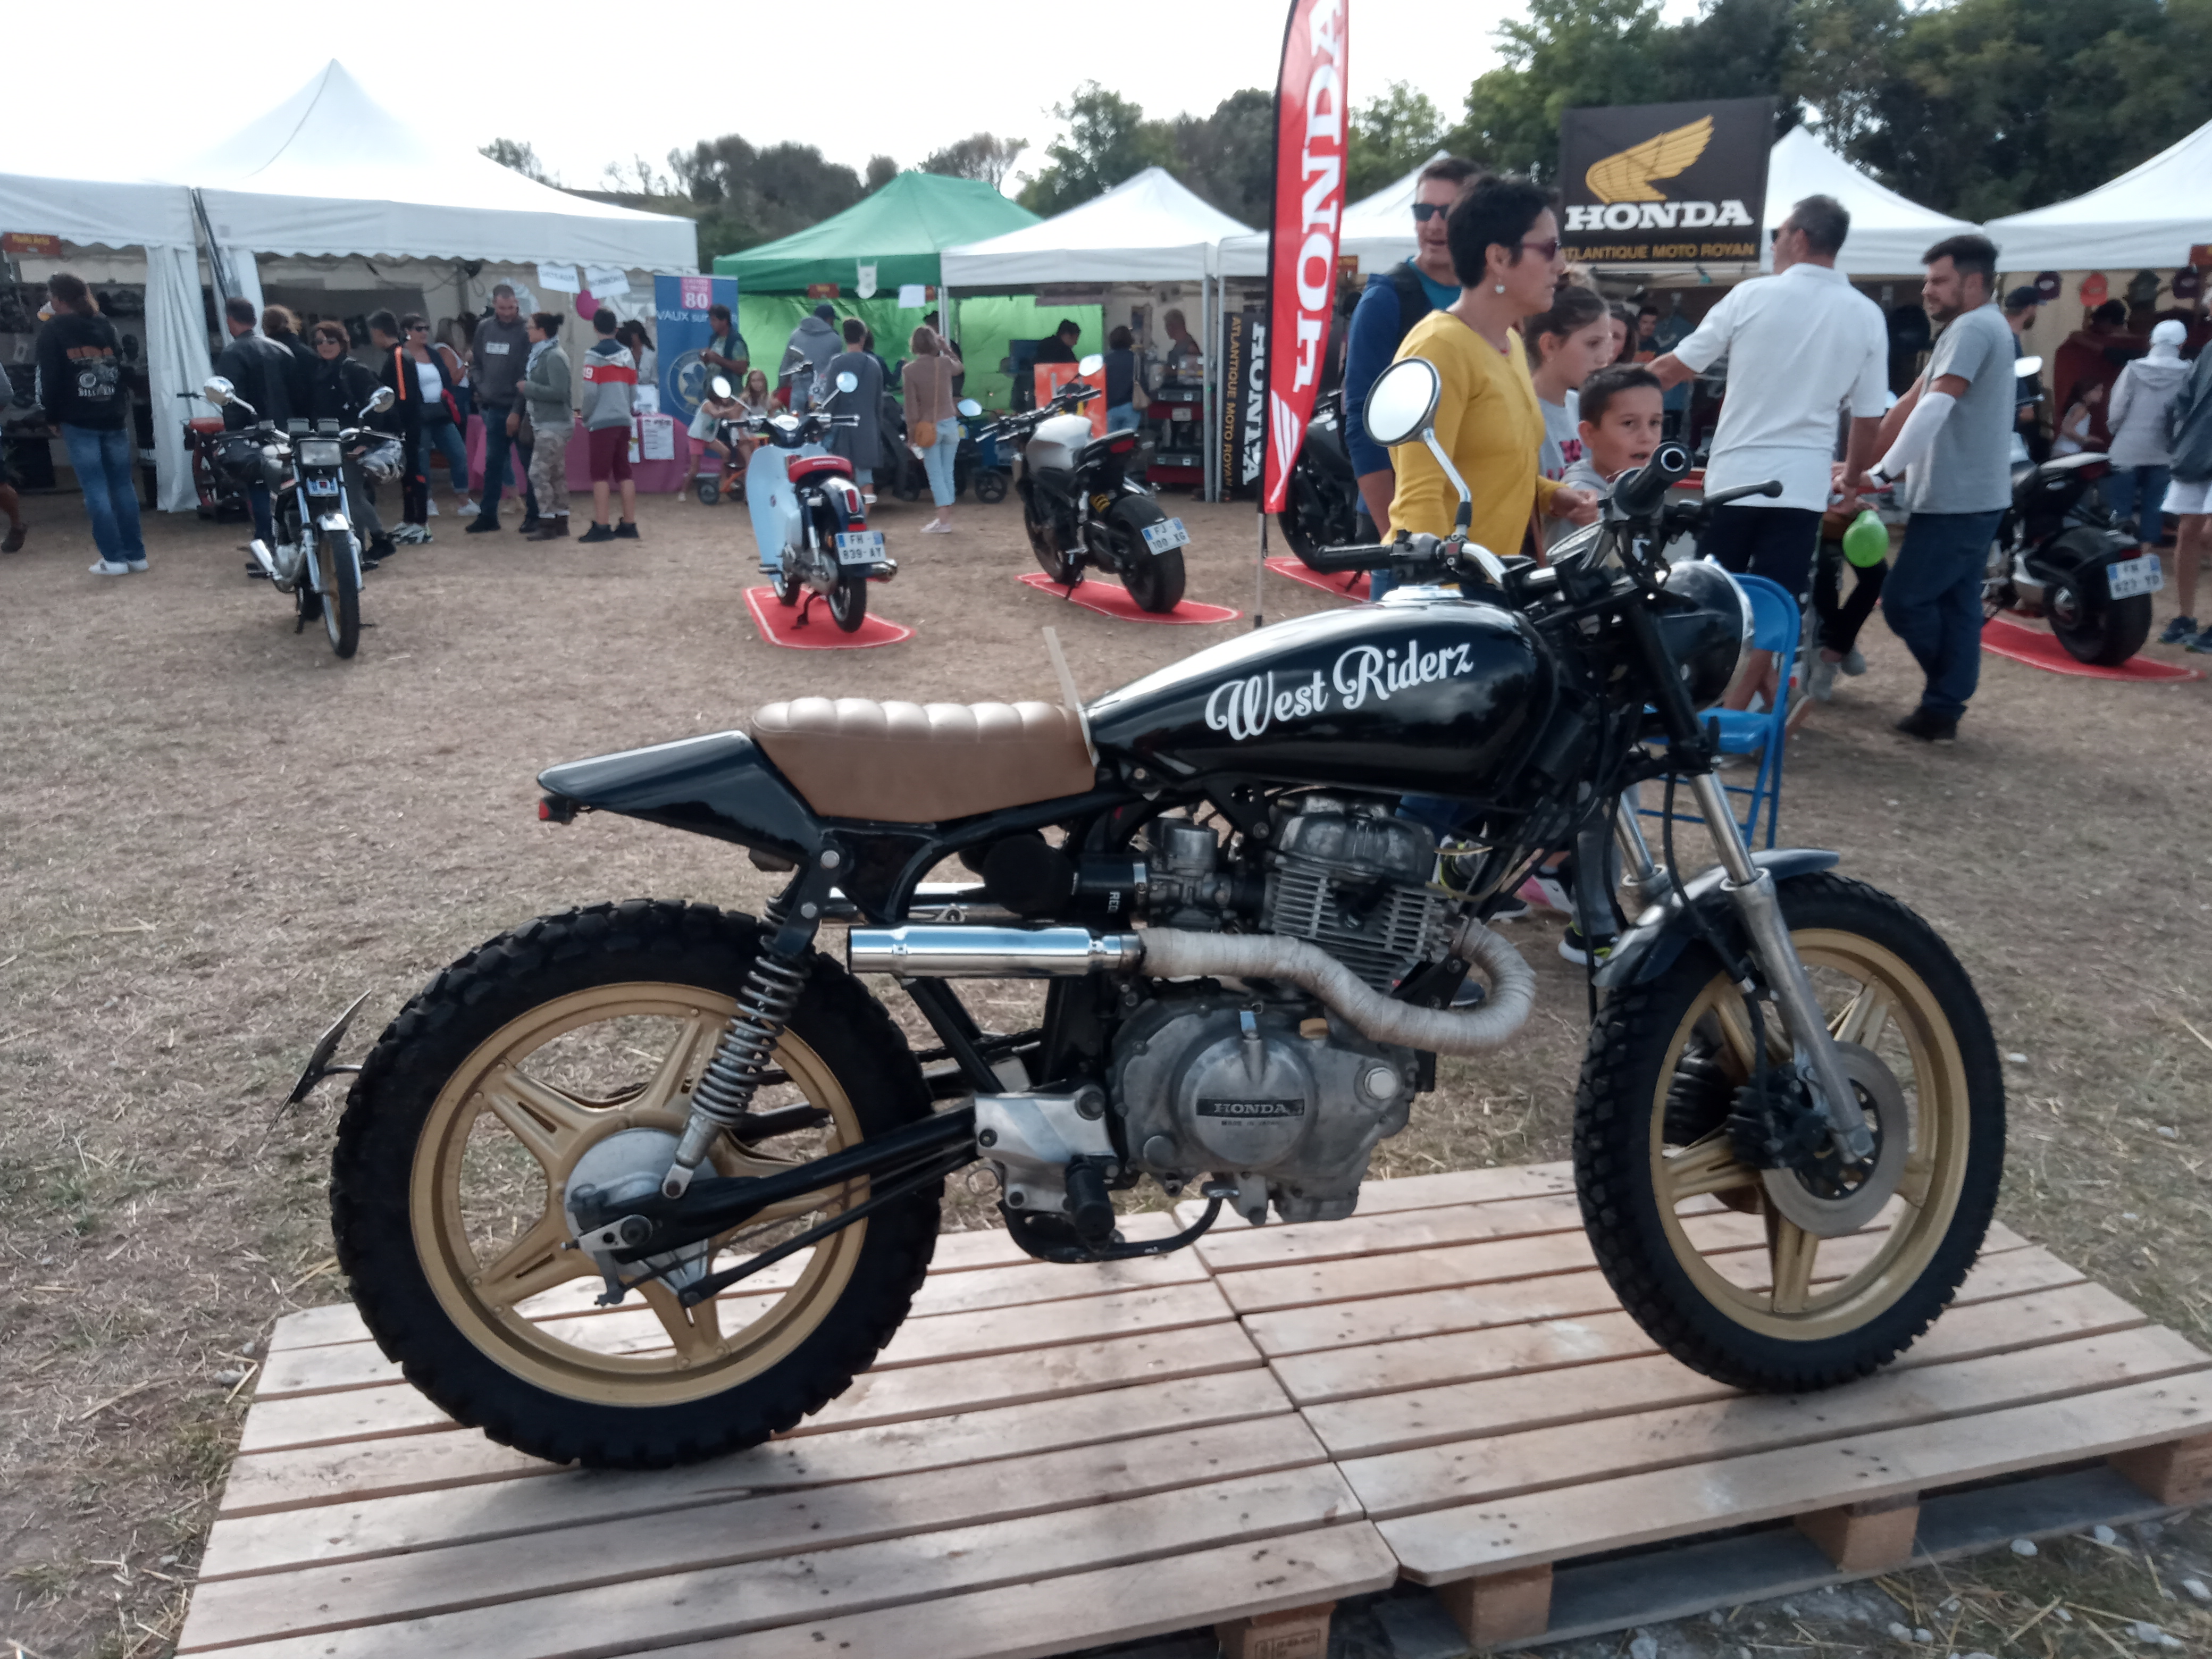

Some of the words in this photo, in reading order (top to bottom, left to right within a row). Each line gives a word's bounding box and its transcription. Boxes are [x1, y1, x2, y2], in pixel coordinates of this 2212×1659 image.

[1293, 0, 1342, 392] HONDA
[1564, 199, 1755, 231] HONDA
[1652, 244, 1699, 258] MOTO
[1701, 242, 1755, 256] ROYAN
[656, 309, 690, 322] VAUX
[685, 292, 709, 309] 80
[1227, 315, 1243, 399] ATLANTIQUE
[1225, 402, 1236, 442] MOTO
[1223, 445, 1234, 487] ROYAN
[1205, 670, 1329, 740] West
[1332, 640, 1474, 710] Riderz
[1214, 1103, 1288, 1114] HONDA
